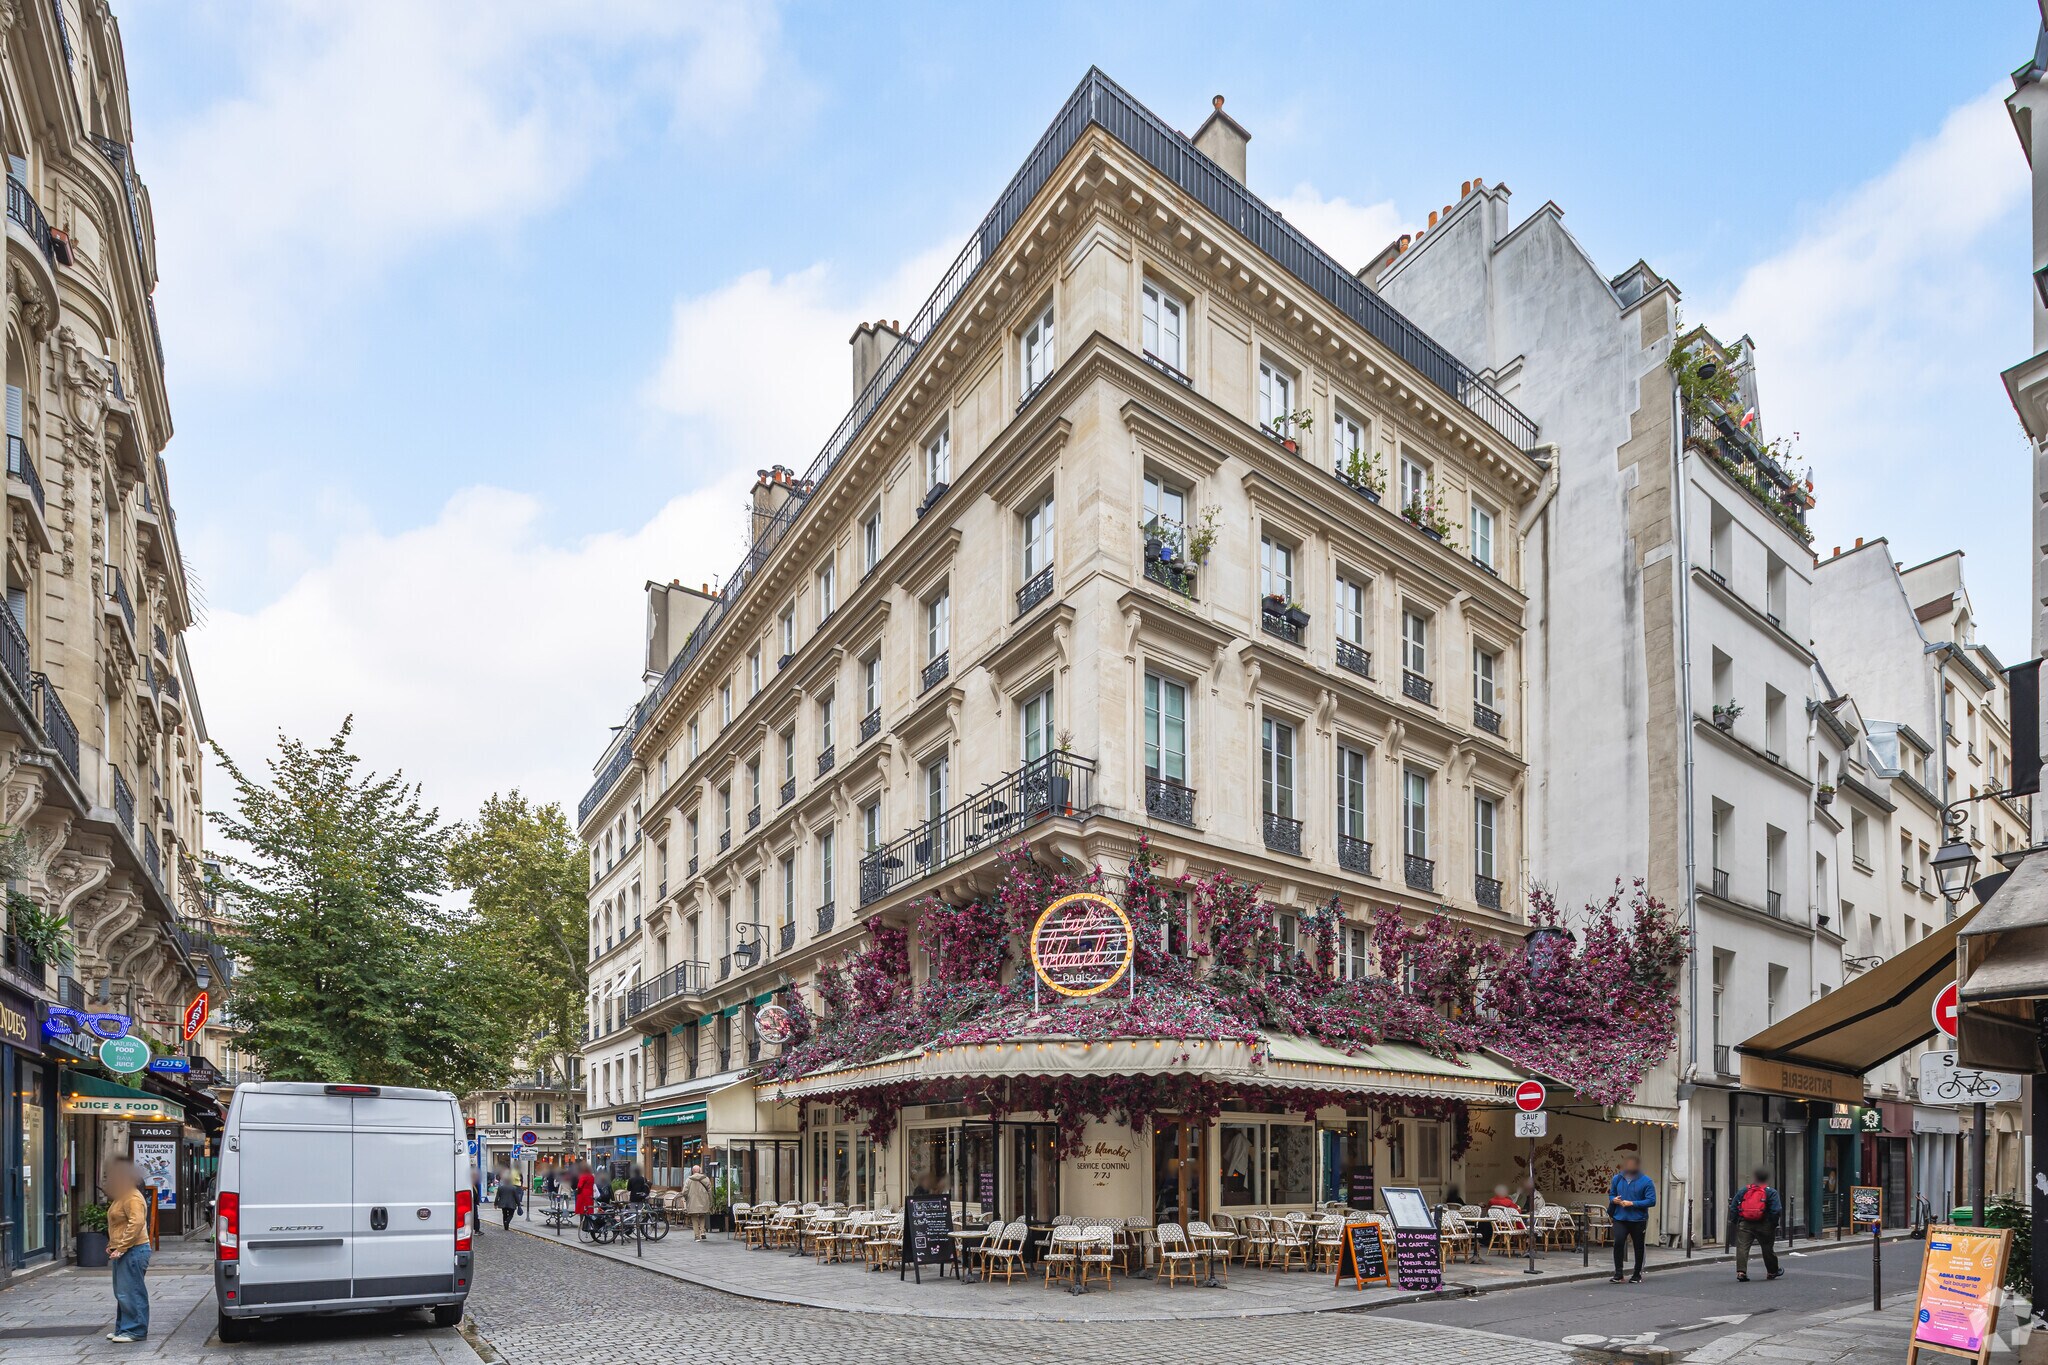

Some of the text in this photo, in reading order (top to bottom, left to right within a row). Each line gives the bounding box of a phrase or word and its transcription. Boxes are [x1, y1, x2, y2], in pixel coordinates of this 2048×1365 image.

[187, 999, 205, 1033] TABAC
[109, 1040, 140, 1048] NATURAL
[72, 1101, 109, 1109] JUICE
[1079, 1145, 1092, 1161] afé
[1077, 1162, 1130, 1170] SERVICE CONTINU
